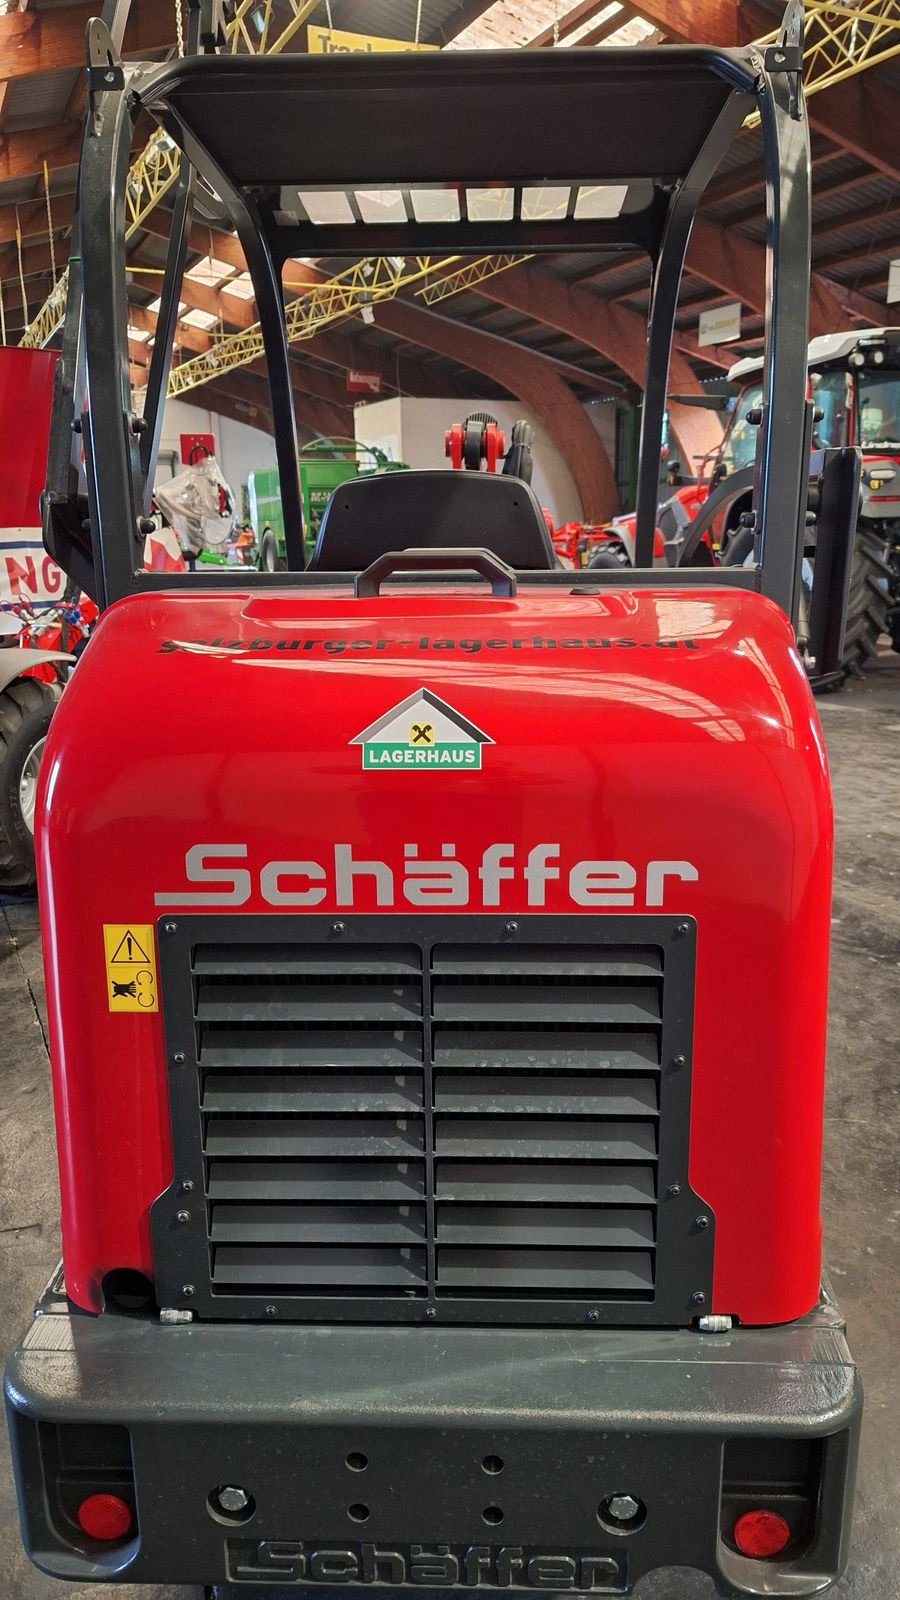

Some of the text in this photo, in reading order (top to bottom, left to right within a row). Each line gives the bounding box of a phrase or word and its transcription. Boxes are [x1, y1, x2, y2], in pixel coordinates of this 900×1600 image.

[368, 749, 476, 764] LAGERHAUS
[154, 843, 699, 907] Schäffer
[236, 1541, 618, 1590] Schäffer
